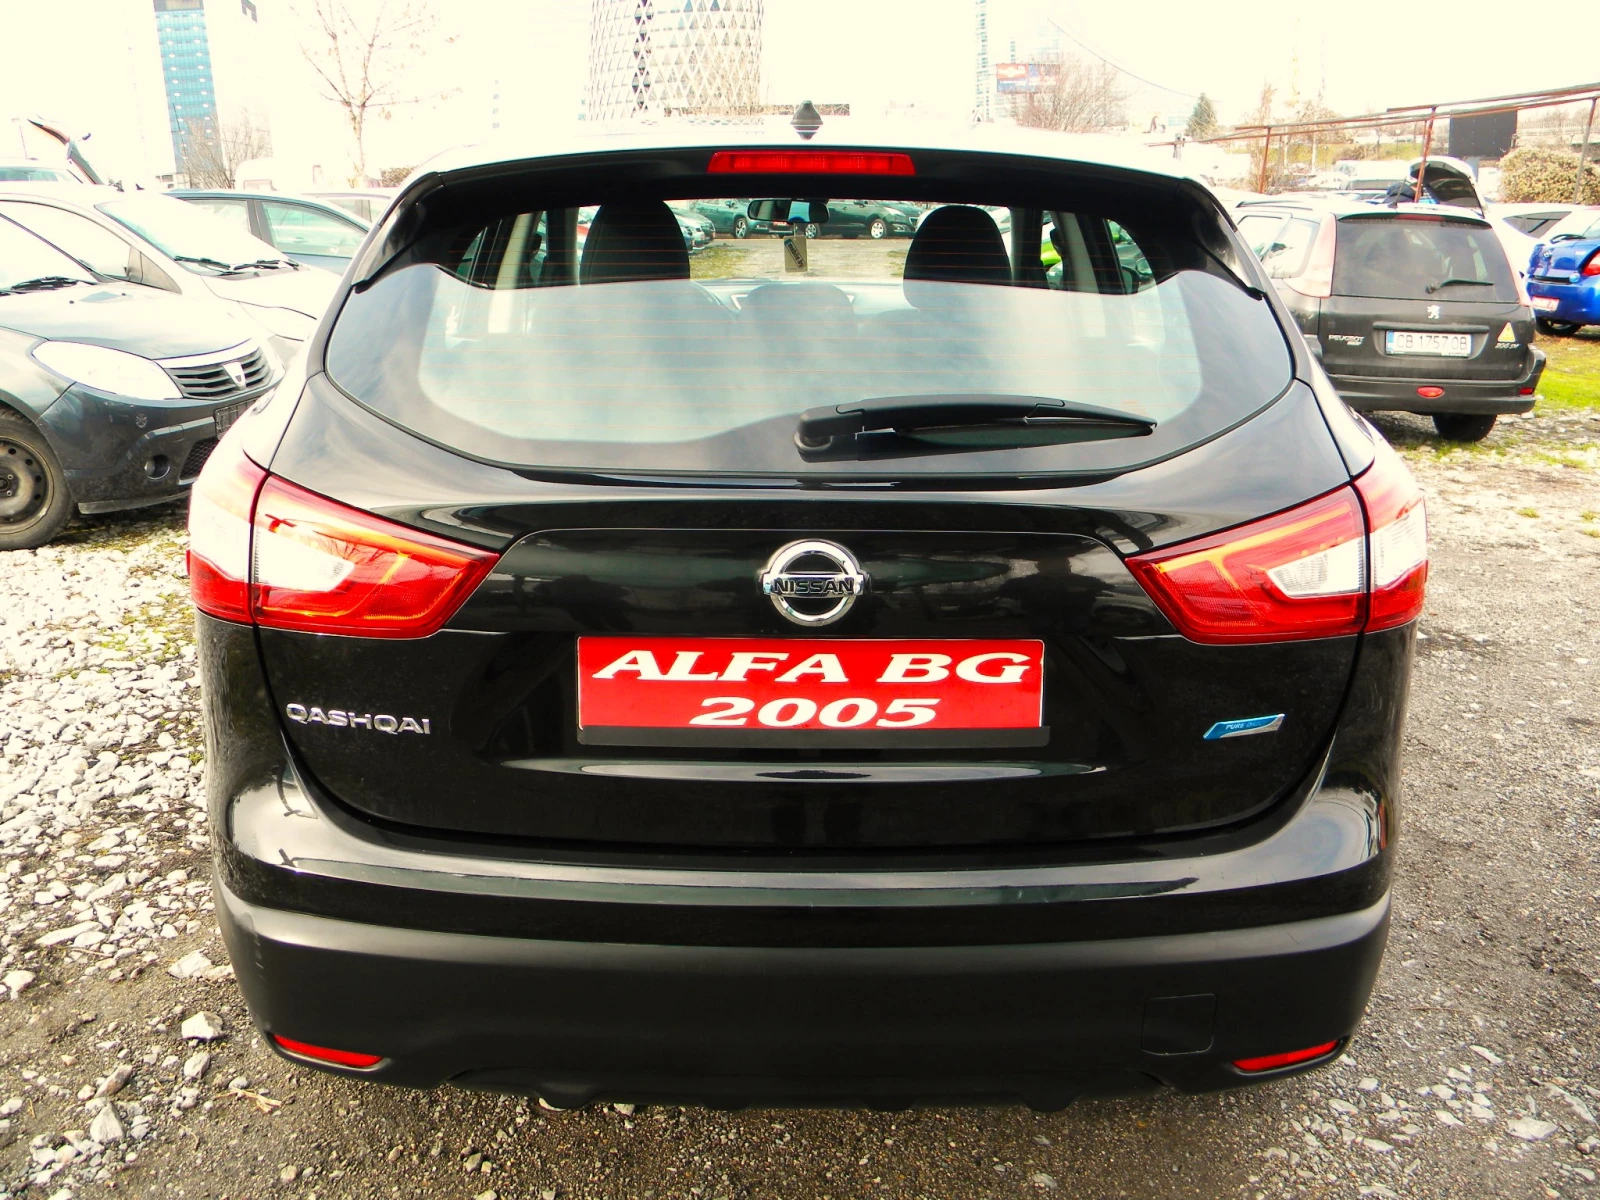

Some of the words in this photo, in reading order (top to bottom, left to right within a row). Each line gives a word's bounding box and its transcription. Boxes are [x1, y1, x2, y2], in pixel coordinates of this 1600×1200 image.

[1397, 334, 1414, 348] CB
[1420, 335, 1449, 349] 1757
[774, 578, 854, 595] NISSAN
[592, 650, 848, 683] ALFA
[876, 652, 1031, 684] BG
[286, 703, 431, 735] QASHQAI
[689, 697, 941, 727] 2005
[1226, 722, 1244, 730] PURE
